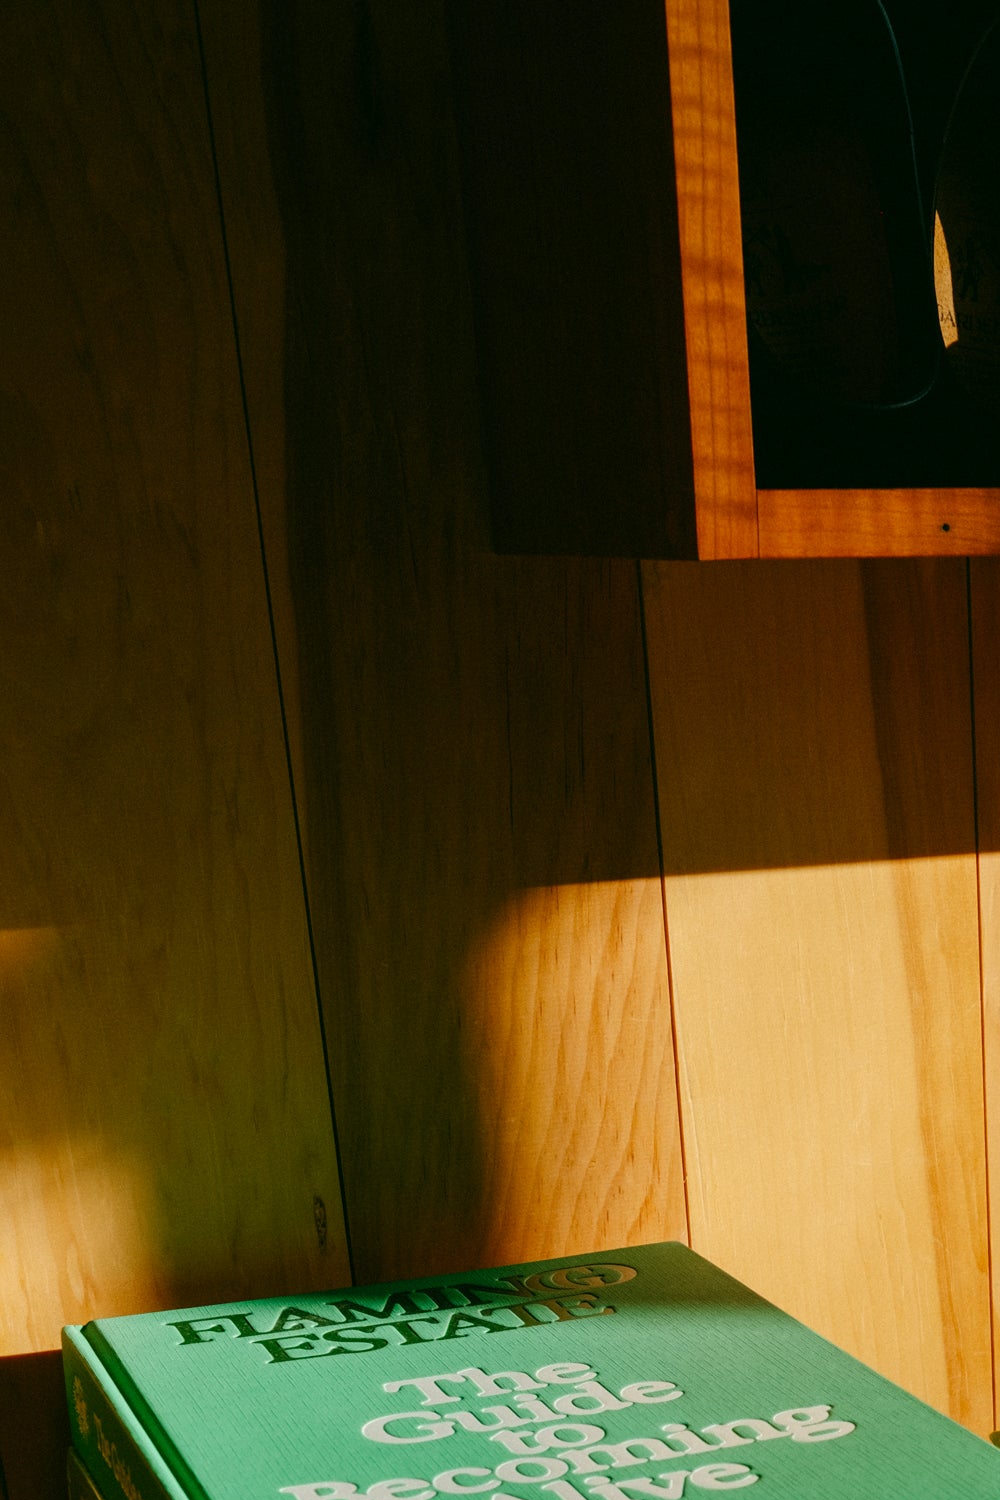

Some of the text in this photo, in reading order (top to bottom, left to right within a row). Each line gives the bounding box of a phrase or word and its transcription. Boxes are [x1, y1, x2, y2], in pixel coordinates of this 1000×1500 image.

[164, 1263, 638, 1348] FLAMINGO
[250, 1293, 619, 1364] ESTATE
[361, 1380, 685, 1447] Guide
[383, 1361, 600, 1409] The
[489, 1421, 606, 1458] to
